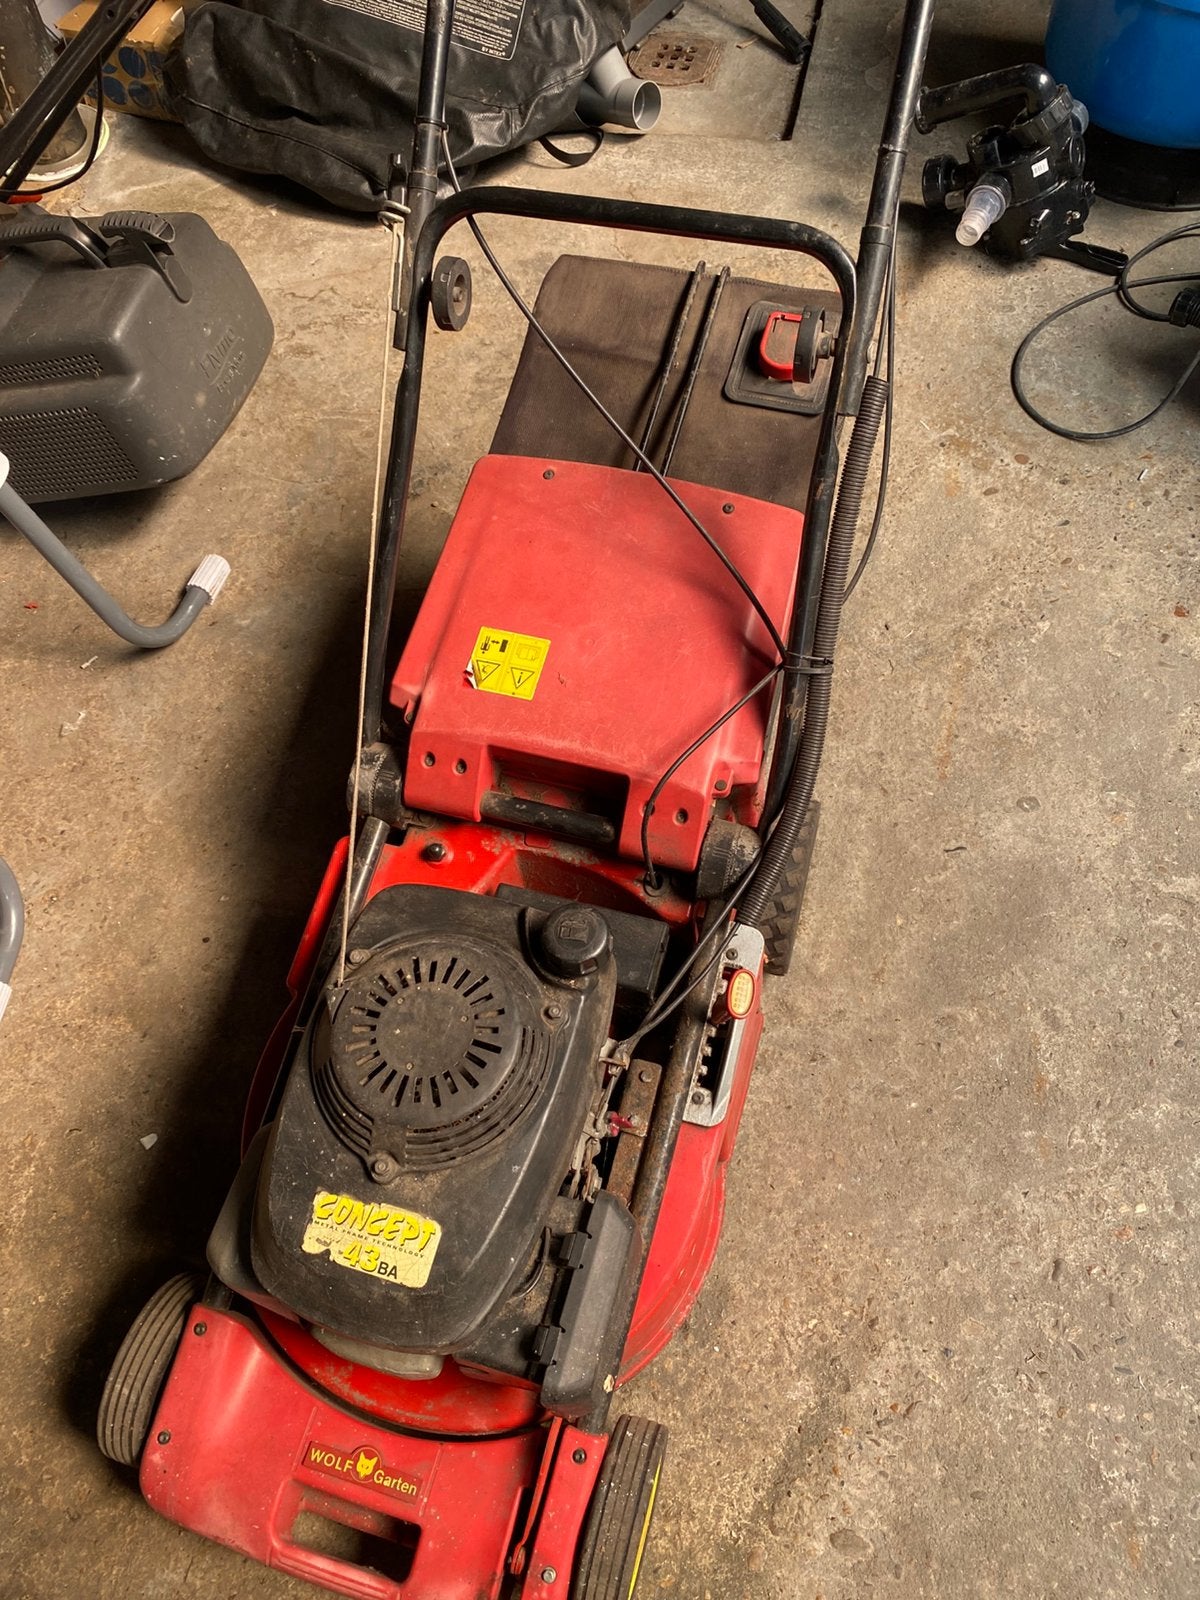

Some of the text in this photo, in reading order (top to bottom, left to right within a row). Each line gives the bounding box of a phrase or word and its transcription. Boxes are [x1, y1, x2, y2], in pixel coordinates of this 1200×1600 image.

[314, 1220, 424, 1259] METAL FRAME TECHNOLOGY
[315, 1194, 436, 1252] CONCEPT
[310, 1447, 418, 1496] WOLF Garten
